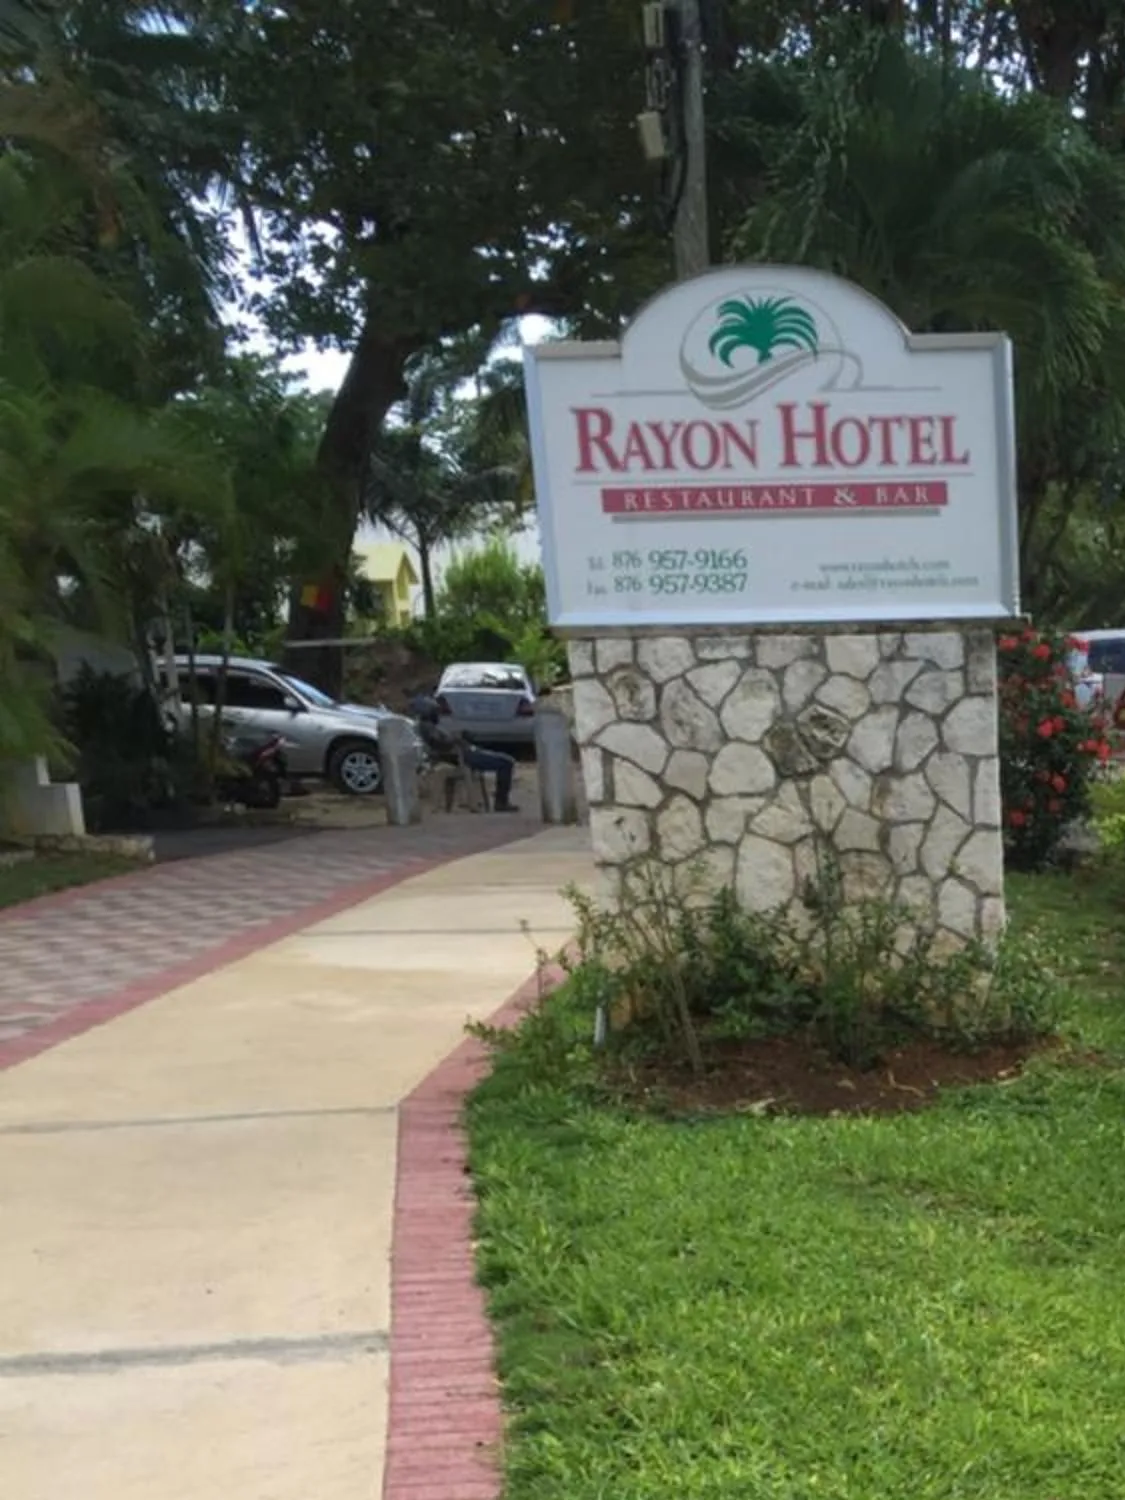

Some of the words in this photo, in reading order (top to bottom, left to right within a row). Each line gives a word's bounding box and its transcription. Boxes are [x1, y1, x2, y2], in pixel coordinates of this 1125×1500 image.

[570, 405, 760, 473] RAYON
[776, 401, 971, 468] HOTEL
[623, 487, 816, 511] RESTAURANT
[833, 486, 857, 506] &
[876, 484, 928, 504] BAR
[648, 549, 748, 570] 957-9166
[648, 571, 748, 595] 957-9387
